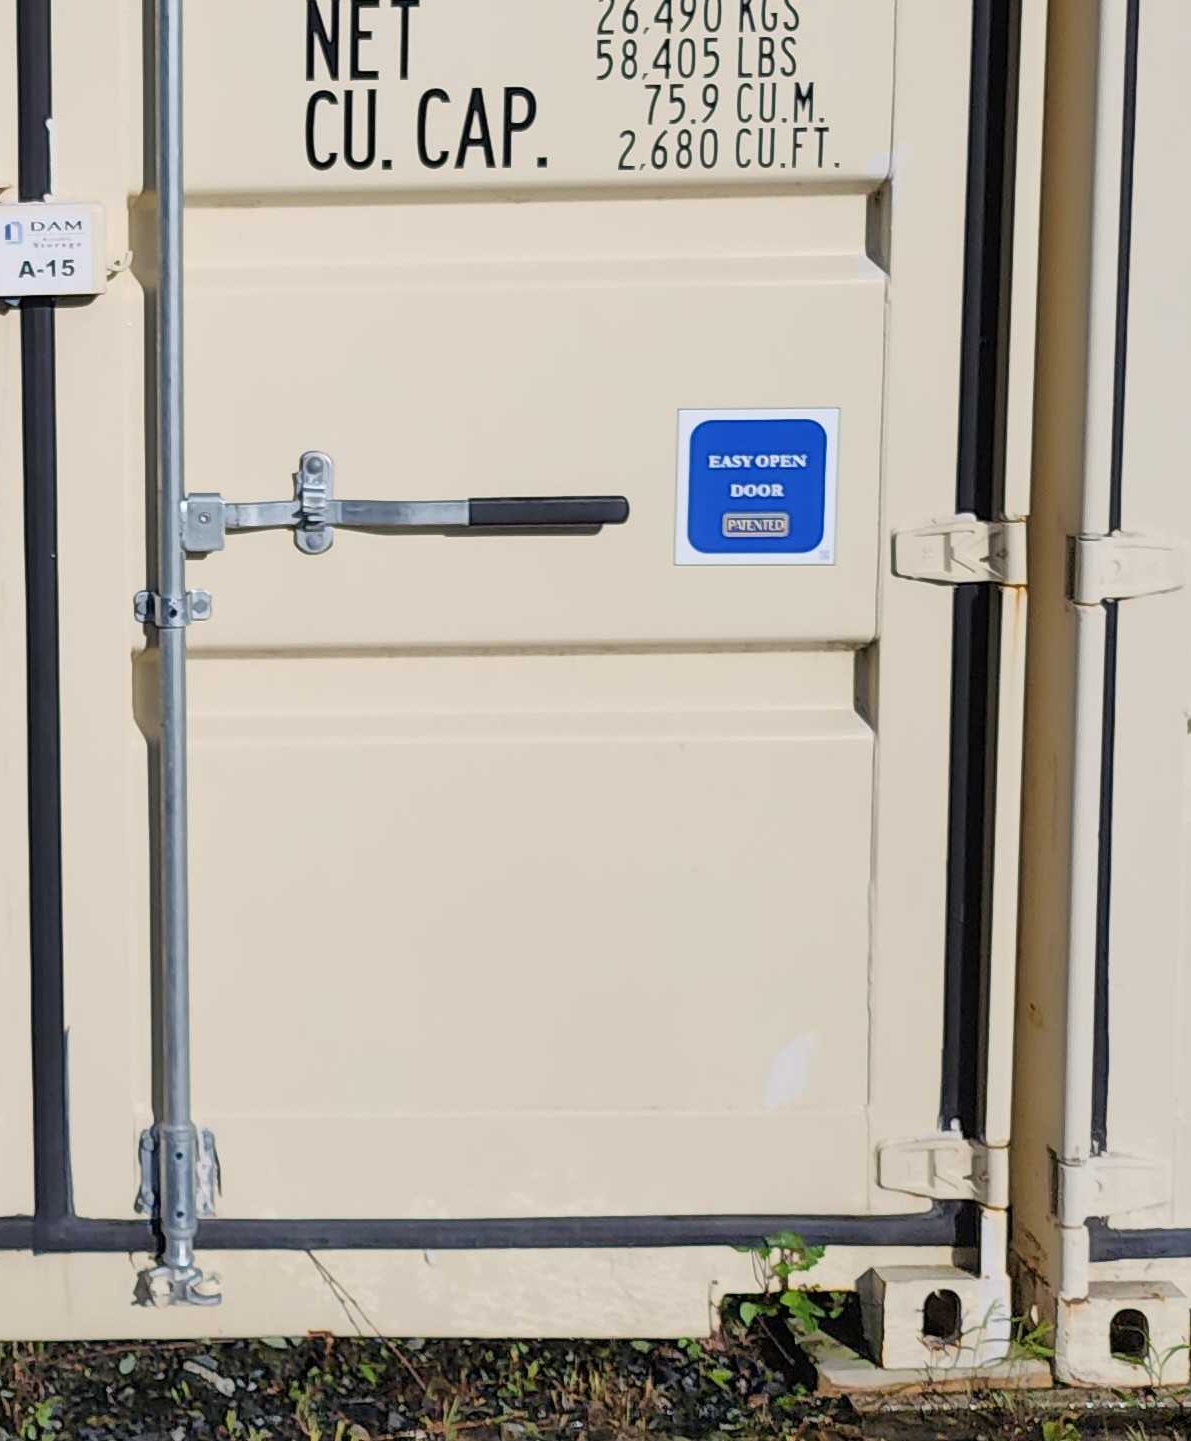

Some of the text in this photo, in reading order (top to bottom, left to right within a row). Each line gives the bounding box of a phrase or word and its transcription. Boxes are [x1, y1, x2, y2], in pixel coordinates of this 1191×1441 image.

[596, 36, 797, 81] 58,405 LBS
[644, 83, 719, 126] 75.9
[305, 86, 548, 171] CU. CAP.
[617, 128, 719, 171] 2,680
[30, 220, 82, 232] DAM
[18, 259, 75, 278] A-15
[708, 454, 808, 468] EASY OPEN
[730, 483, 785, 497] DOOR
[728, 519, 785, 531] PATENTED
